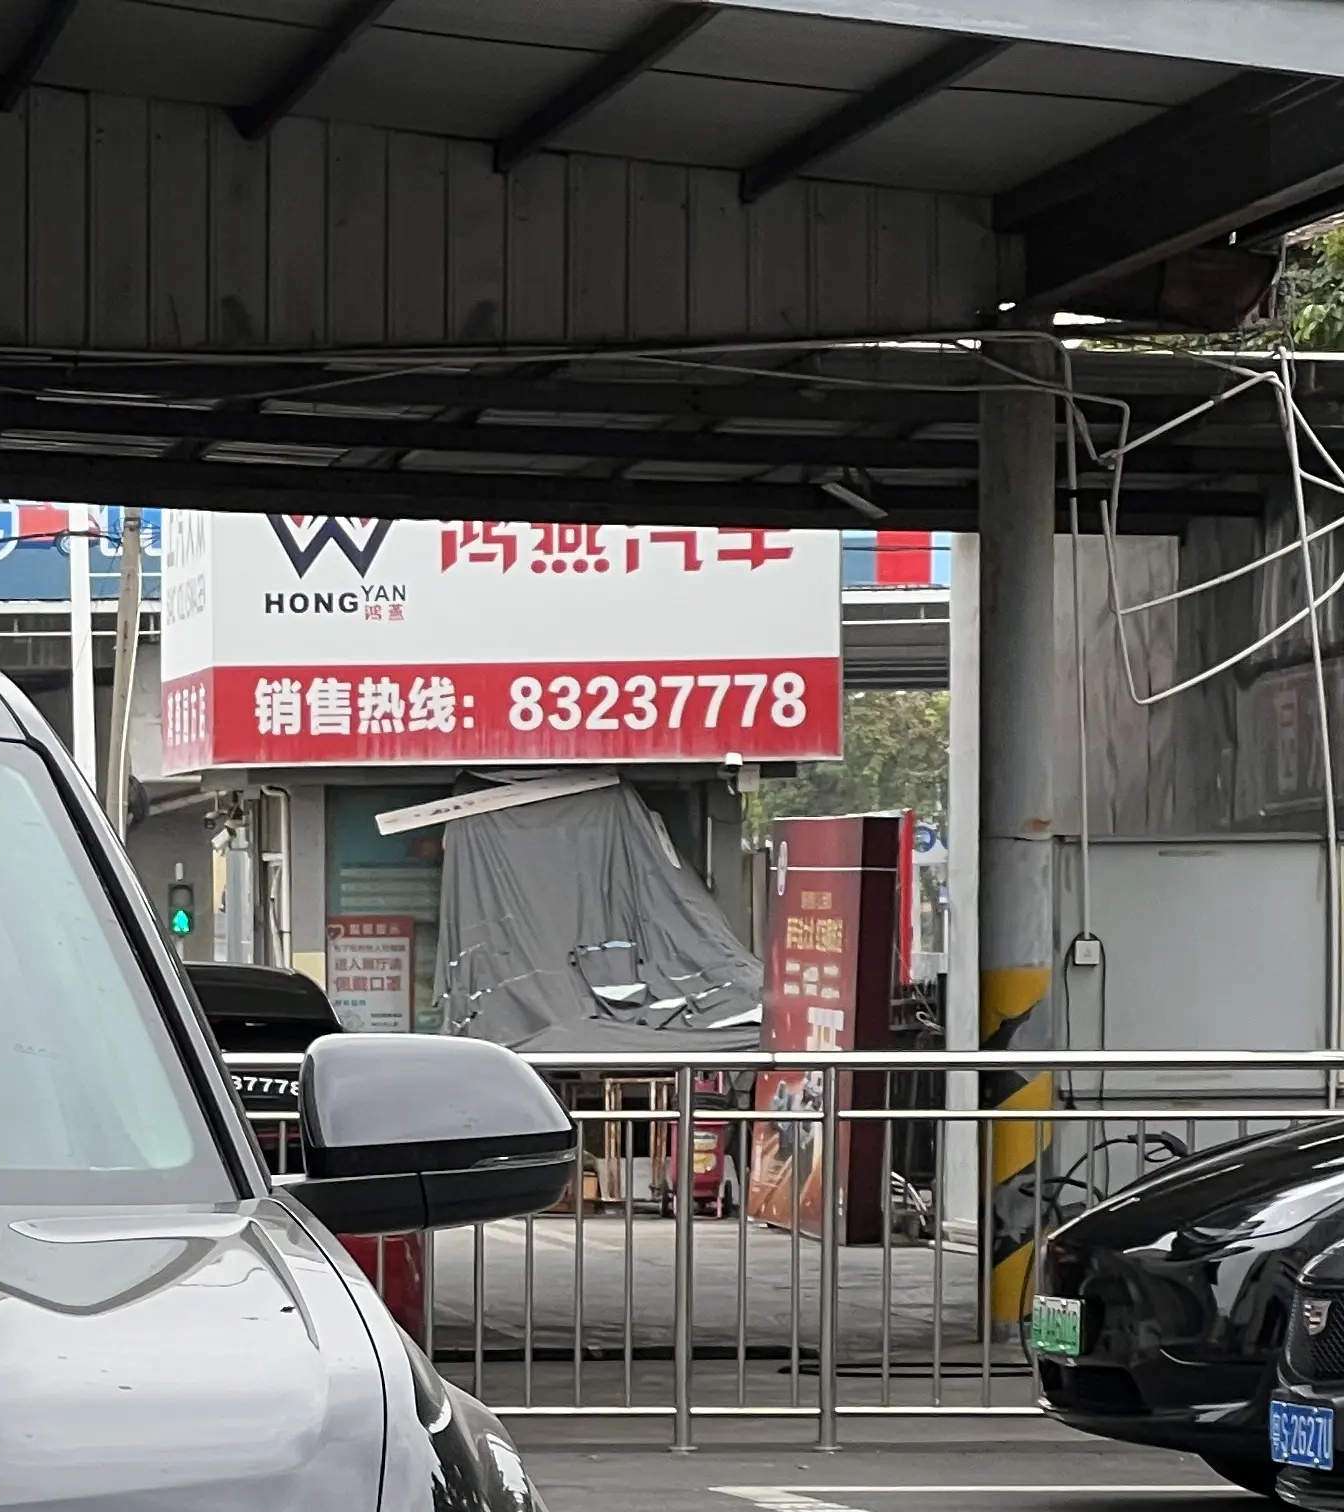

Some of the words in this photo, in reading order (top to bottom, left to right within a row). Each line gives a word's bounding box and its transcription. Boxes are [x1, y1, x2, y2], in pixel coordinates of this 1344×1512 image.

[265, 592, 358, 614] HONG
[361, 584, 406, 602] YAN
[255, 676, 474, 735] 销售热线：
[509, 672, 806, 731] 83237778
